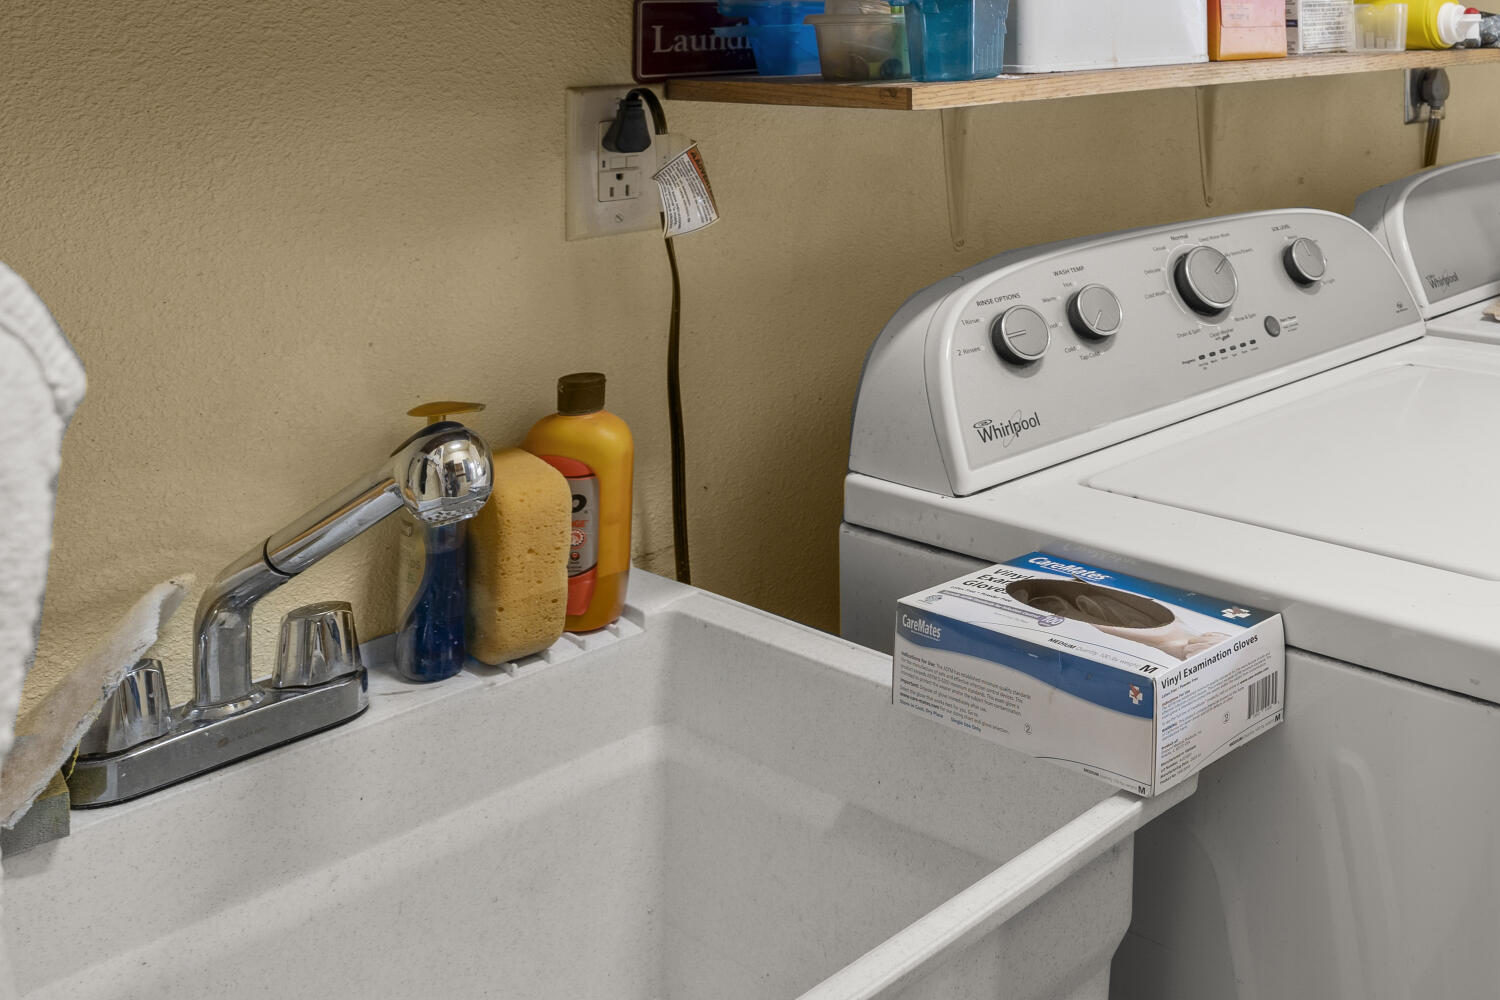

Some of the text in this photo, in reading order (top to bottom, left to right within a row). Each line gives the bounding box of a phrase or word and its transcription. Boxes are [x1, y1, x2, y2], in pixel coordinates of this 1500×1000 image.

[1170, 232, 1189, 241] Normal
[1053, 269, 1070, 277] WASH
[1428, 271, 1459, 289] Whirlpool
[976, 292, 1021, 307] RINSE OPTIONS
[965, 317, 980, 326] Rinse
[976, 411, 1041, 443] Whirlpool
[1028, 557, 1110, 580] CareMates
[902, 614, 942, 639] CareMates
[1048, 637, 1077, 650] MEDIUM
[1139, 664, 1159, 674] M
[1161, 633, 1259, 690] Vinyl Examination Gloves
[1274, 713, 1281, 723] M
[1138, 785, 1146, 795] M
